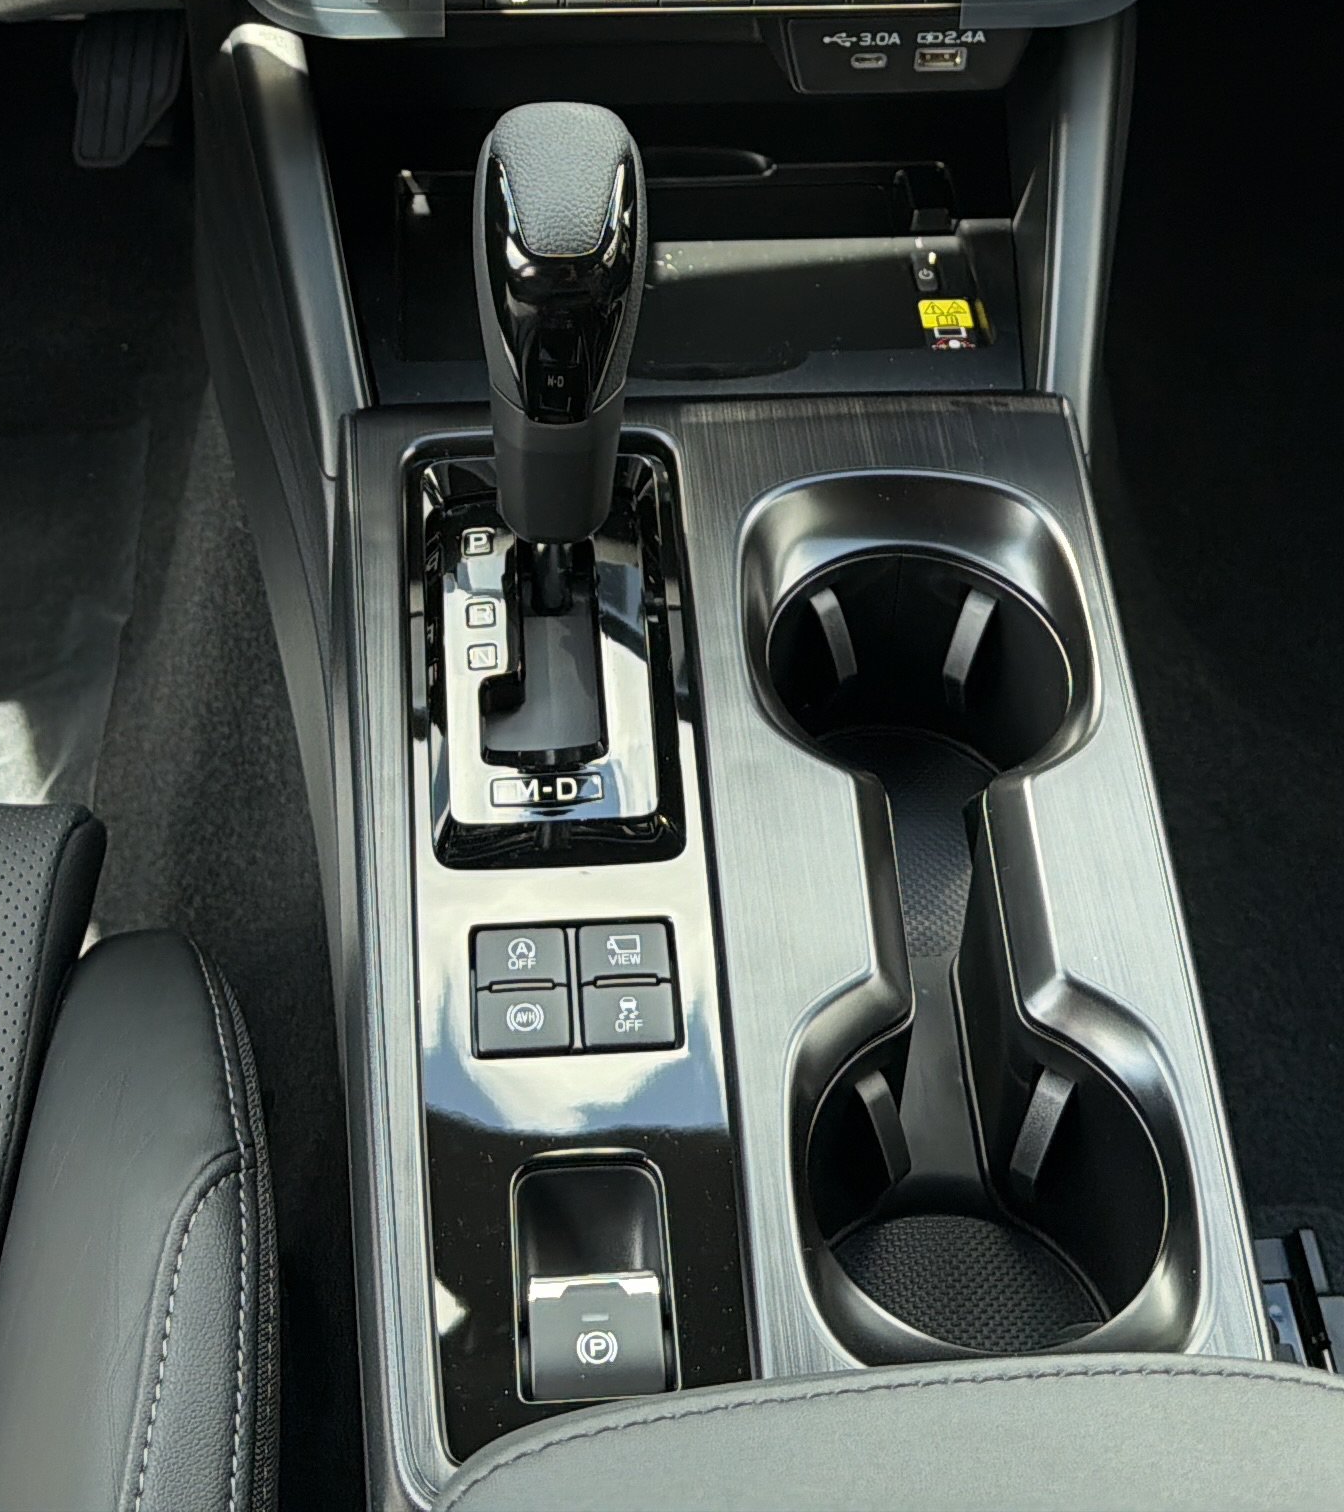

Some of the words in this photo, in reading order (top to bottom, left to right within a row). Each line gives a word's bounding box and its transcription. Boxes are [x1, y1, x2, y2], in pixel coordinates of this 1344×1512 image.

[859, 32, 901, 46] 3.0A
[943, 31, 987, 44] 2.4A
[469, 533, 489, 552] P
[518, 777, 578, 802] M-D
[507, 958, 537, 970] OFF
[608, 953, 641, 966] VIEW
[515, 1011, 536, 1024] AVH
[614, 1019, 644, 1033] OFF
[589, 1338, 607, 1357] P
